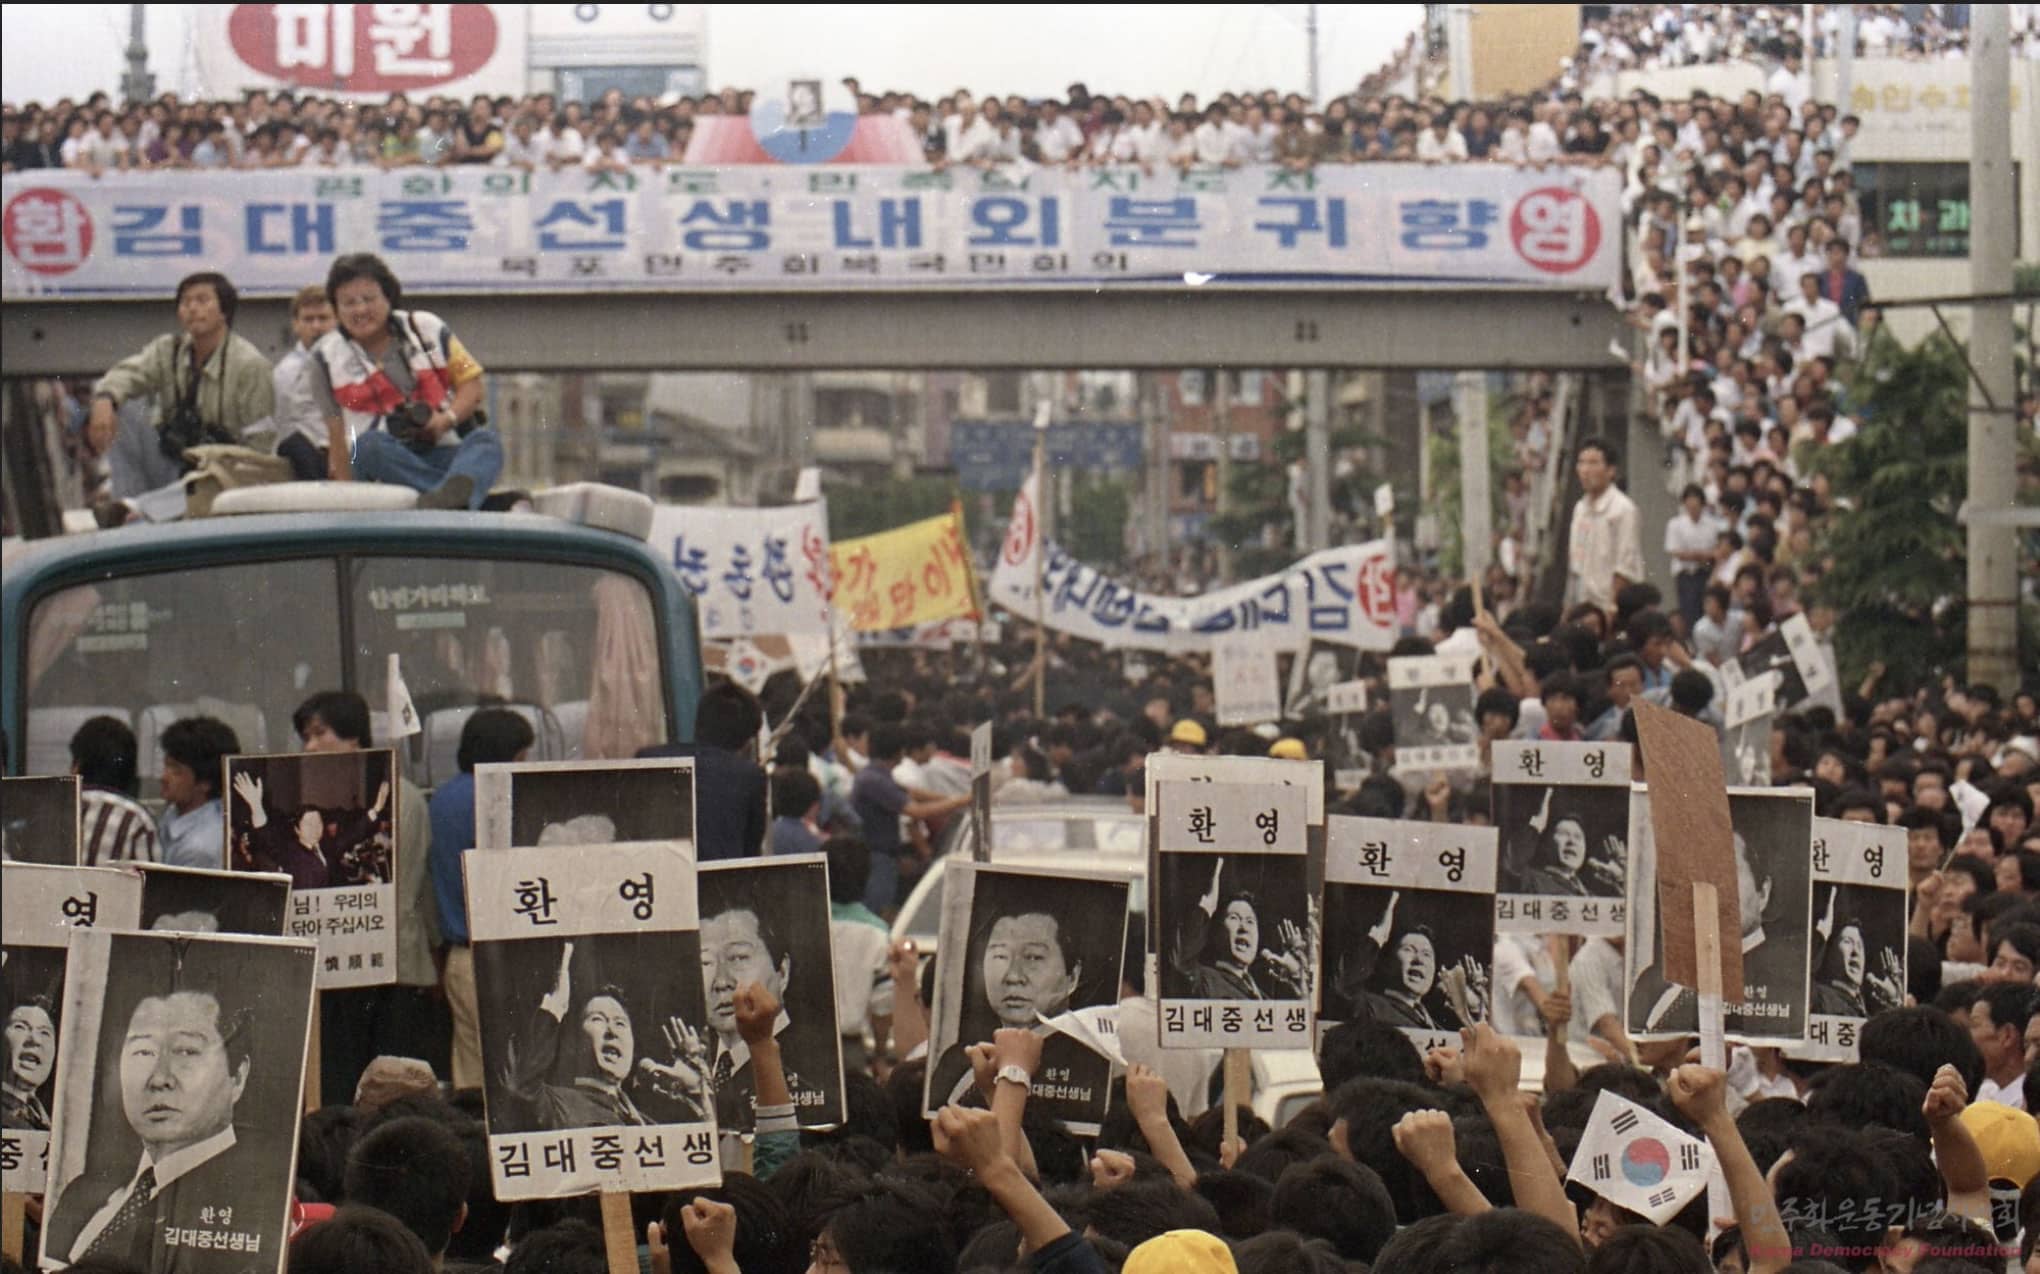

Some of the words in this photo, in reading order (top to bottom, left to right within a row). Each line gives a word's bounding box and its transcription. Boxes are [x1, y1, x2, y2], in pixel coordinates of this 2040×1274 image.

[272, 4, 455, 75] 미원
[1188, 807, 1278, 845] 환영
[1358, 841, 1466, 883] 환영
[334, 892, 377, 911] 우리의
[514, 872, 655, 925] 환영
[326, 915, 385, 935] 주십시오
[1165, 1005, 1307, 1033] 김대중선생
[1028, 1083, 1092, 1103] 대중선생님
[499, 1131, 714, 1178] 김대중선생
[200, 1206, 233, 1225] 환영
[165, 1227, 261, 1254] 김대중선생님
